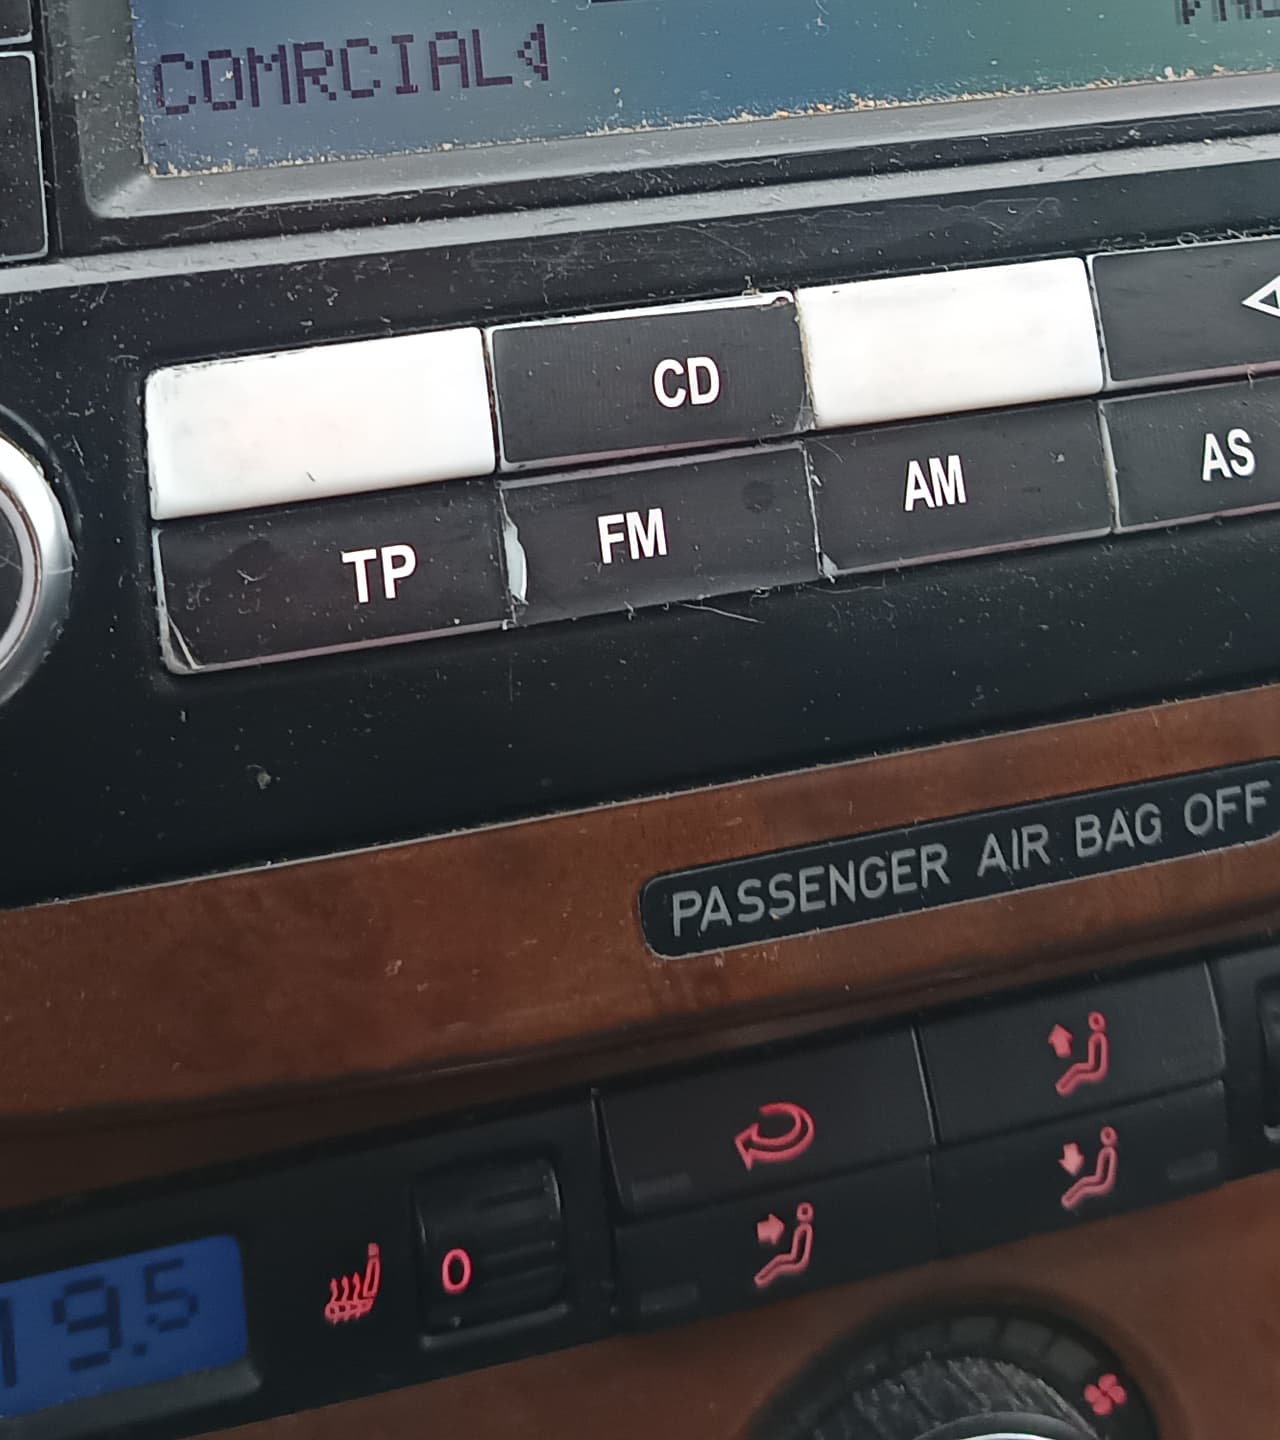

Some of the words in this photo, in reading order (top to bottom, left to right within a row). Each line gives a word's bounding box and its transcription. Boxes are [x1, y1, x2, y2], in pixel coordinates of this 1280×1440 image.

[154, 27, 513, 115] COMRCIAL
[653, 356, 721, 409] CD
[903, 454, 968, 512] AM
[1202, 429, 1256, 481] AS
[597, 508, 668, 564] FM
[341, 544, 418, 604] TP
[671, 843, 951, 937] PASSENGER
[976, 824, 1049, 879] AIR
[1075, 803, 1162, 859] BAG
[1183, 780, 1271, 837] OFF
